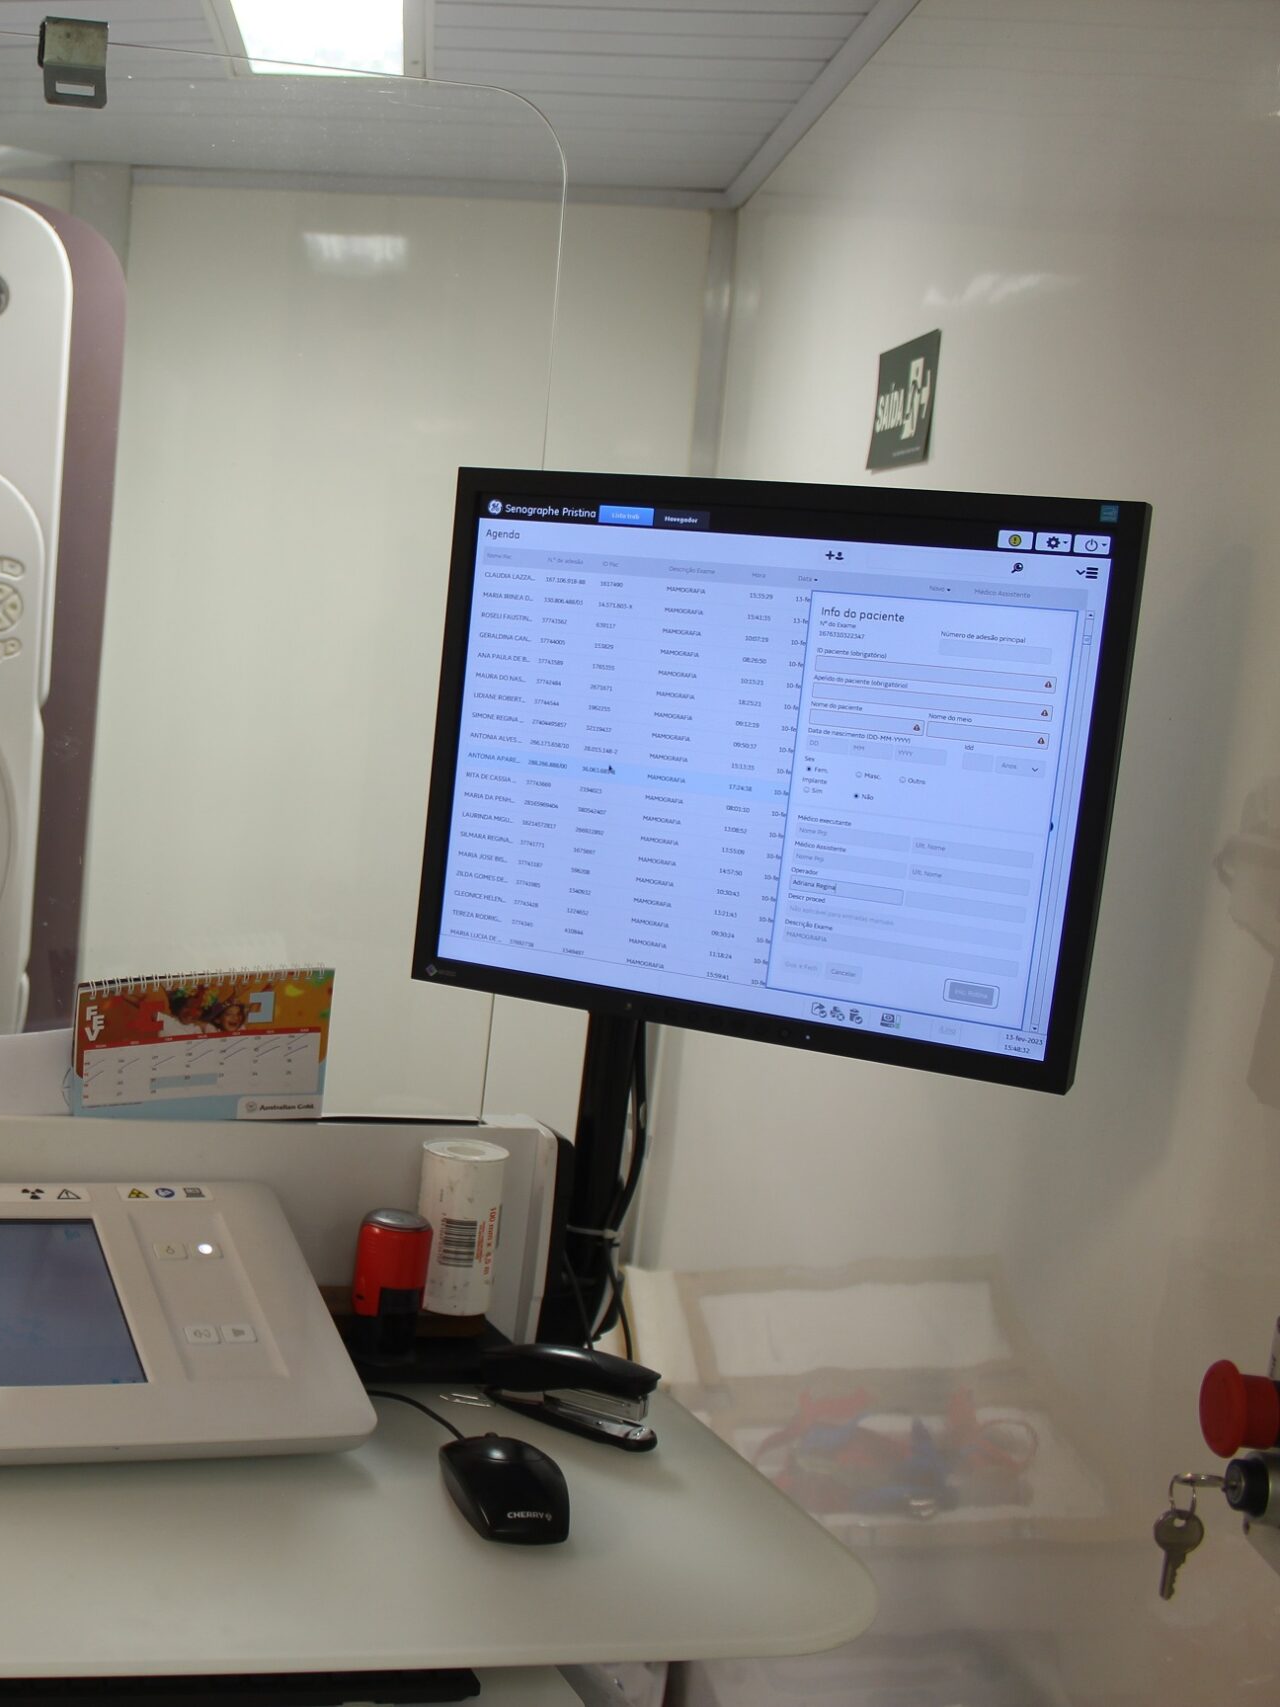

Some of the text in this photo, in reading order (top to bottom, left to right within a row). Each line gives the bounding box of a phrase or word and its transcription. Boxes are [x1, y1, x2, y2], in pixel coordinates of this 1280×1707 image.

[875, 382, 905, 433] SAÍDA
[504, 504, 559, 517] Senographe
[561, 507, 596, 517] Pristina
[486, 528, 520, 541] Agenda
[666, 586, 706, 594] MAMOGRAFIA
[664, 607, 704, 615] MAMOGRAFIA
[821, 606, 905, 624] Info do paciente
[661, 628, 702, 636] MAMOGRAFIA
[940, 629, 965, 638] Número
[975, 633, 998, 641] adesão
[999, 635, 1026, 645] principal
[659, 649, 699, 658] MAMOGRAFIA
[657, 670, 697, 679] MAMOGRAFIA
[655, 691, 695, 700] MAMOGRAFIA
[653, 712, 693, 721] MAMOGRAFIA
[651, 733, 691, 742] MAMOGRAFIA
[831, 730, 865, 738] nascimento
[649, 753, 689, 763] MAMOGRAFIA
[646, 774, 686, 784] MAMOGRAFIA
[802, 777, 827, 785] Implante
[644, 795, 684, 804] MAMOGRAFIA
[642, 815, 681, 825] MAMOGRAFIA
[797, 814, 851, 826] Médico executante
[639, 836, 679, 846] MAMOGRAFIA
[794, 840, 846, 852] Médico Assistente
[637, 856, 677, 866] MAMOGRAFIA
[791, 867, 818, 875] Operador
[635, 877, 674, 887] MAMOGRAFIA
[792, 879, 836, 891] Adriana Regina
[632, 897, 672, 908] MAMOGRAFIA
[630, 917, 669, 928] MAMOGRAFIA
[784, 918, 833, 931] Descrição Exame
[628, 937, 667, 948] MAMOGRAFIA
[626, 958, 665, 969] MAMOGRAFIA
[84, 1005, 105, 1041] FEV
[1005, 1033, 1043, 1045] 13-fev-2023
[507, 1511, 544, 1520] CHERRY
